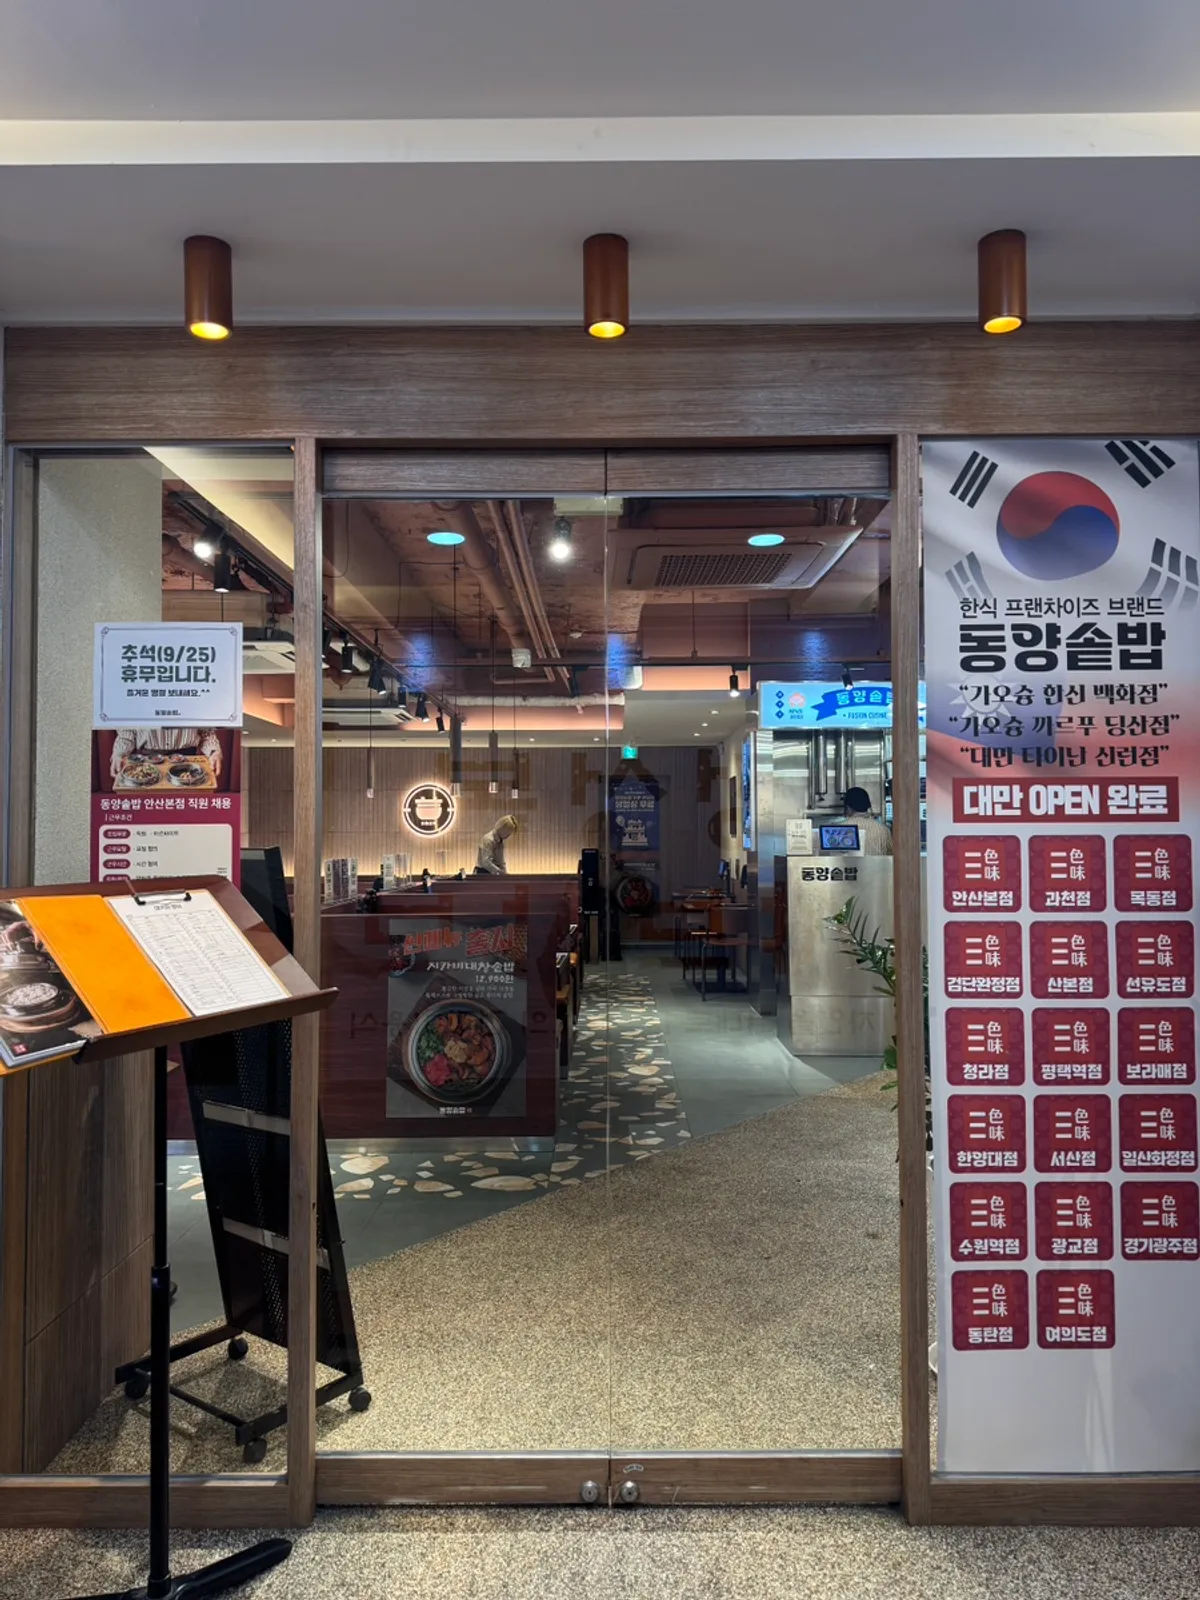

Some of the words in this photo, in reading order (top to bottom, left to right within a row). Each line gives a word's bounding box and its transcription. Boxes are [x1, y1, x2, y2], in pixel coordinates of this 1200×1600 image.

[959, 597, 998, 619] 한식
[1004, 597, 1101, 619] 프랜차이즈
[1106, 597, 1165, 618] 브랜드
[121, 644, 216, 663] 추석(9/25)
[958, 622, 1167, 673] 동양솥밥
[121, 664, 216, 683] 휴무입니다.
[126, 689, 149, 697] 즐거운
[151, 689, 166, 697] 명절
[1043, 683, 1085, 706] 한신
[1032, 715, 1098, 737] 까르푸
[1021, 746, 1087, 768] 타이난
[143, 798, 185, 810] 안산본점
[188, 797, 209, 809] 직원
[211, 797, 232, 809] 채용
[963, 785, 1023, 816] 대만
[1029, 784, 1099, 816] OPEN
[1107, 784, 1169, 816] 완료
[952, 891, 1013, 906] 안산본점
[1045, 891, 1091, 907] 과천점
[1130, 890, 1176, 906] 목동점
[403, 927, 463, 956] 신메뉴
[466, 923, 515, 957] 출시
[476, 974, 515, 984] 12,900원
[947, 977, 1020, 992] 검단완정점
[1048, 977, 1093, 993] 산본점
[1126, 977, 1186, 992] 선유도점
[963, 1064, 1009, 1080] 청라점
[1042, 1064, 1102, 1080] 평택역점
[1127, 1063, 1187, 1079] 보라매점
[957, 1151, 1018, 1167] 한양대점
[1051, 1151, 1096, 1167] 서산점
[1122, 1151, 1195, 1166] 일산화정점
[959, 1239, 1020, 1255] 수원역점
[1052, 1239, 1098, 1254] 광교점
[1124, 1238, 1198, 1254] 경기광주점
[968, 1327, 1013, 1343] 동탄점
[1046, 1326, 1106, 1342] 여의도점
